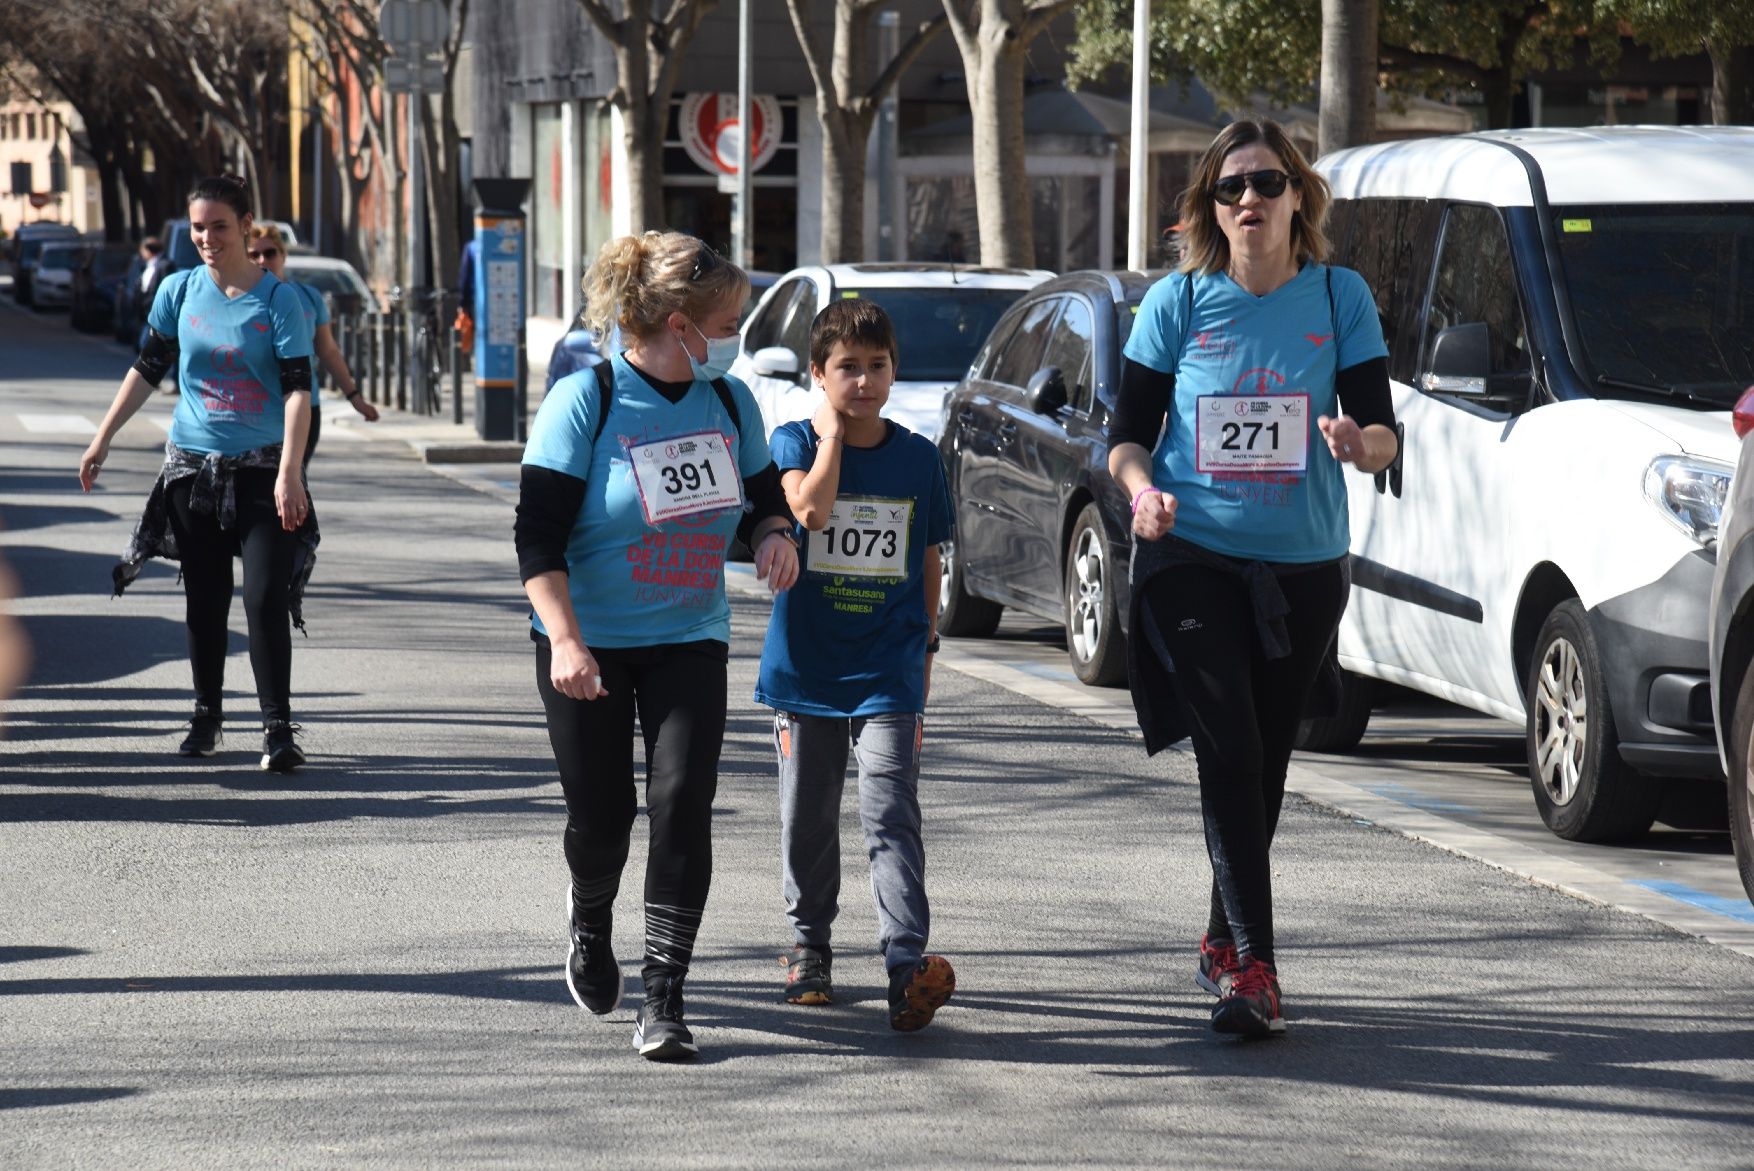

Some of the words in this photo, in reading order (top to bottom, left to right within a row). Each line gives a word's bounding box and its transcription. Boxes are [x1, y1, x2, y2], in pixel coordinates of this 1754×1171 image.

[1221, 422, 1279, 450] 271
[661, 458, 717, 495] 391
[642, 532, 667, 549] VII
[823, 526, 897, 558] 1073
[627, 544, 656, 563] DE
[657, 548, 680, 567] LA
[685, 552, 722, 570] DON
[823, 585, 885, 600] santasusana
[833, 602, 873, 614] MANRESA
